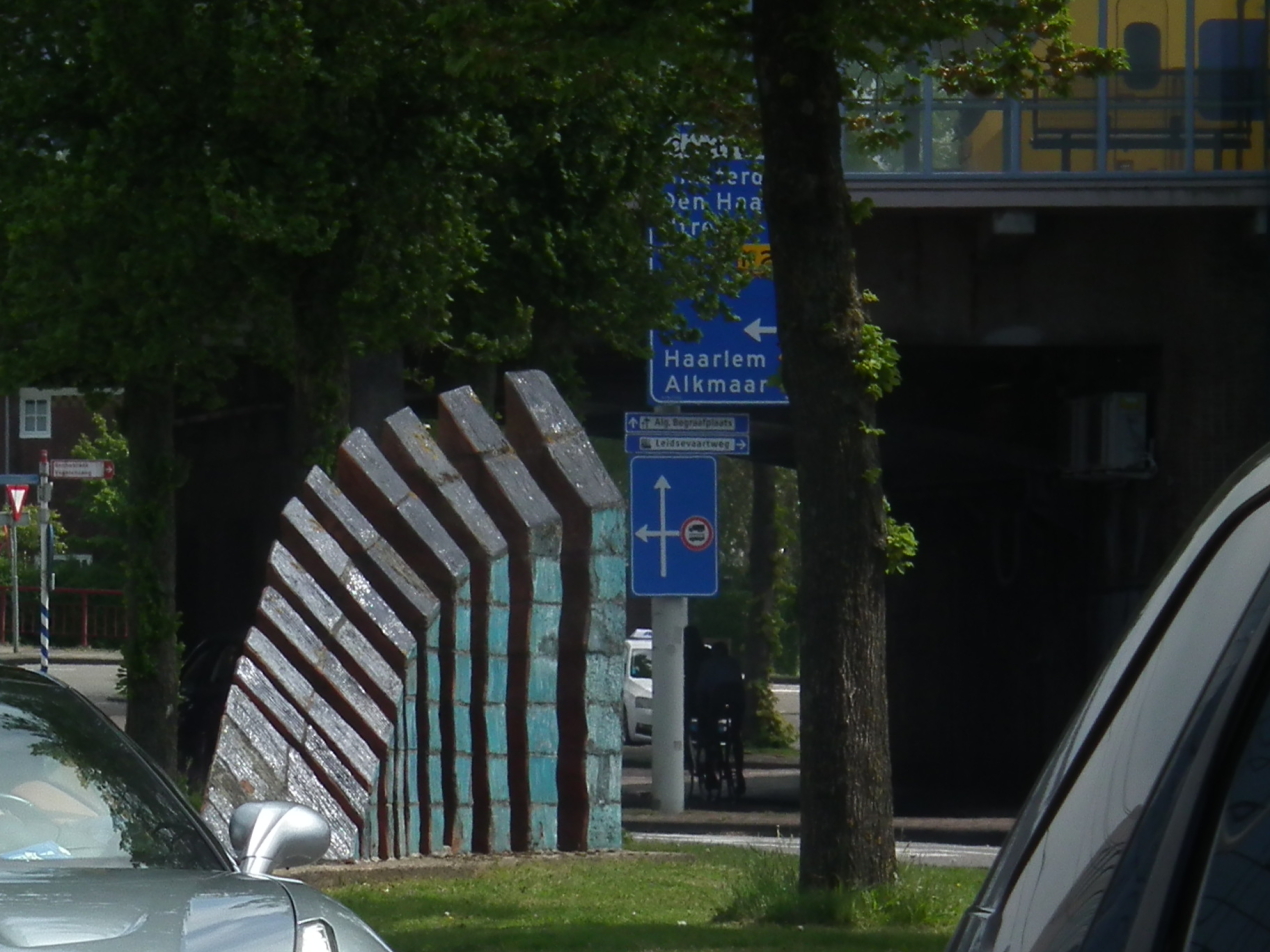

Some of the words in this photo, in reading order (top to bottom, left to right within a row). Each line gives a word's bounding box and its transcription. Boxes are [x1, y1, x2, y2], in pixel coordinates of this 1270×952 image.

[664, 349, 766, 368] Haarlem
[664, 374, 768, 393] Alkmaar
[655, 439, 730, 449] Leidsevaartweg
